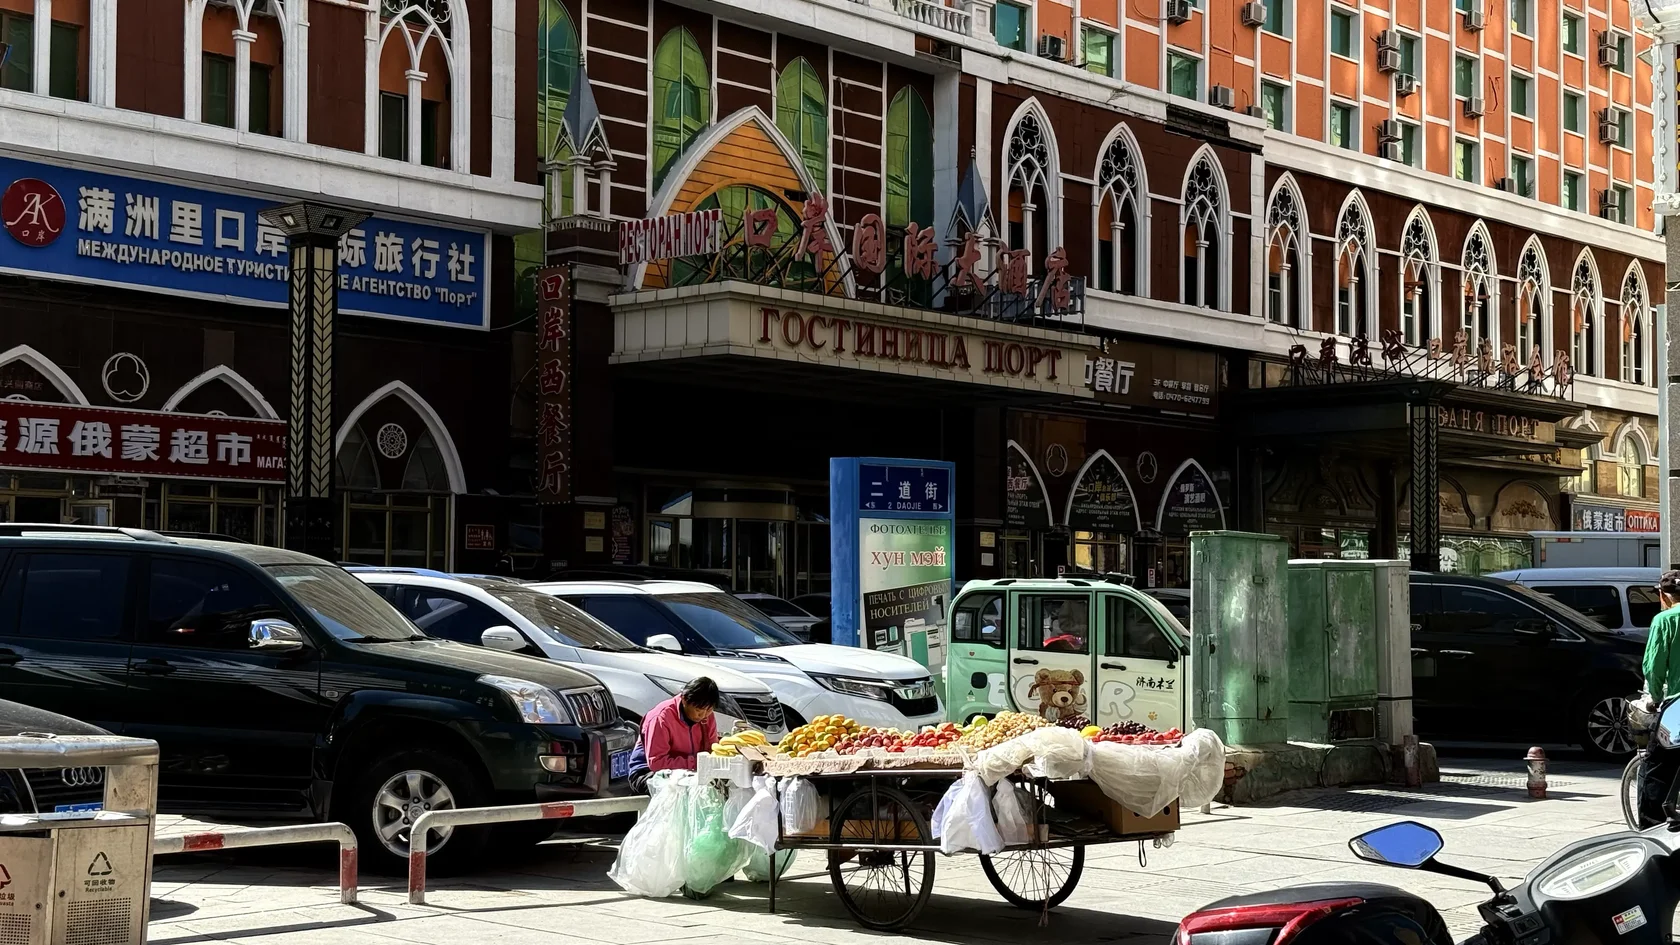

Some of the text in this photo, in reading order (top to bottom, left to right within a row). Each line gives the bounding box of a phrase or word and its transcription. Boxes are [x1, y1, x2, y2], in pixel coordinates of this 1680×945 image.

[22, 230, 45, 242] 口岸
[620, 209, 723, 264] РЕСТОРАН ПОРТ
[744, 193, 1071, 312] 口岸国际大酒店
[78, 239, 223, 273] МЕЖДУНАРОДНОЕ
[352, 276, 431, 301] АГЕНТСТВО
[758, 307, 1062, 380] ГОСТИНИЦА ПОРТ
[538, 274, 568, 495] 口岸西餐厅
[1496, 414, 1540, 440] ПОРТ
[871, 481, 938, 500] 二道街
[897, 502, 922, 510] DAOJIE
[1583, 509, 1625, 532] 俄蒙超市
[1628, 515, 1658, 531] ОПТИКА
[869, 583, 949, 605] ПЕЧАТЬ С ЦИФРОВЫХ
[870, 598, 930, 620] НОСИТЕЛЕЙ
[84, 879, 115, 887] 可回收物
